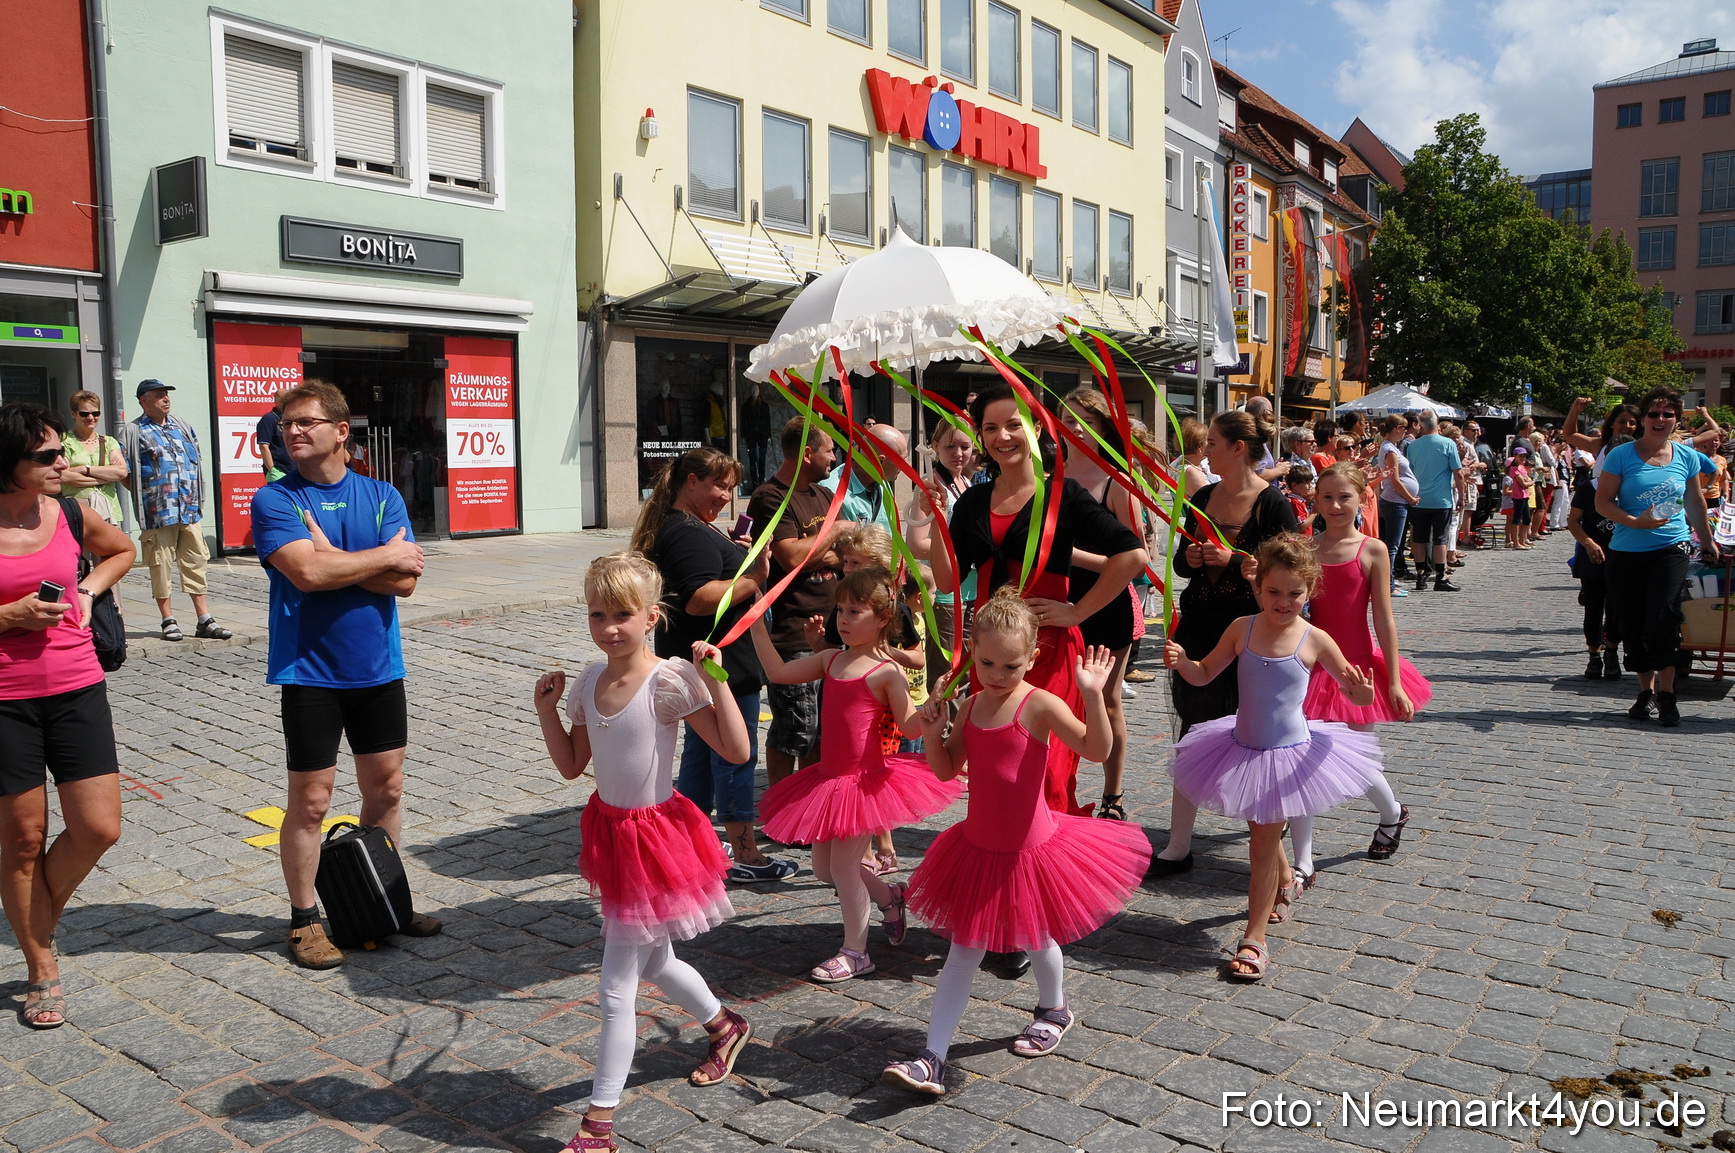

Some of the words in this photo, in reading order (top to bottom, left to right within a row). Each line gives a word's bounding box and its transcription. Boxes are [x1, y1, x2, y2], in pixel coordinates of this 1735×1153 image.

[1234, 165, 1246, 306] BÄCKEREI
[222, 363, 302, 379] RÄUMUNGS-
[449, 372, 511, 387] RÄUMUNGS-
[450, 386, 508, 401] VERKAUF
[456, 431, 506, 456] 70%
[642, 441, 660, 449] NEUE
[661, 441, 702, 449] KOLLEKTION
[1636, 476, 1678, 502] MENEATE
[1649, 482, 1683, 504] GOZA
